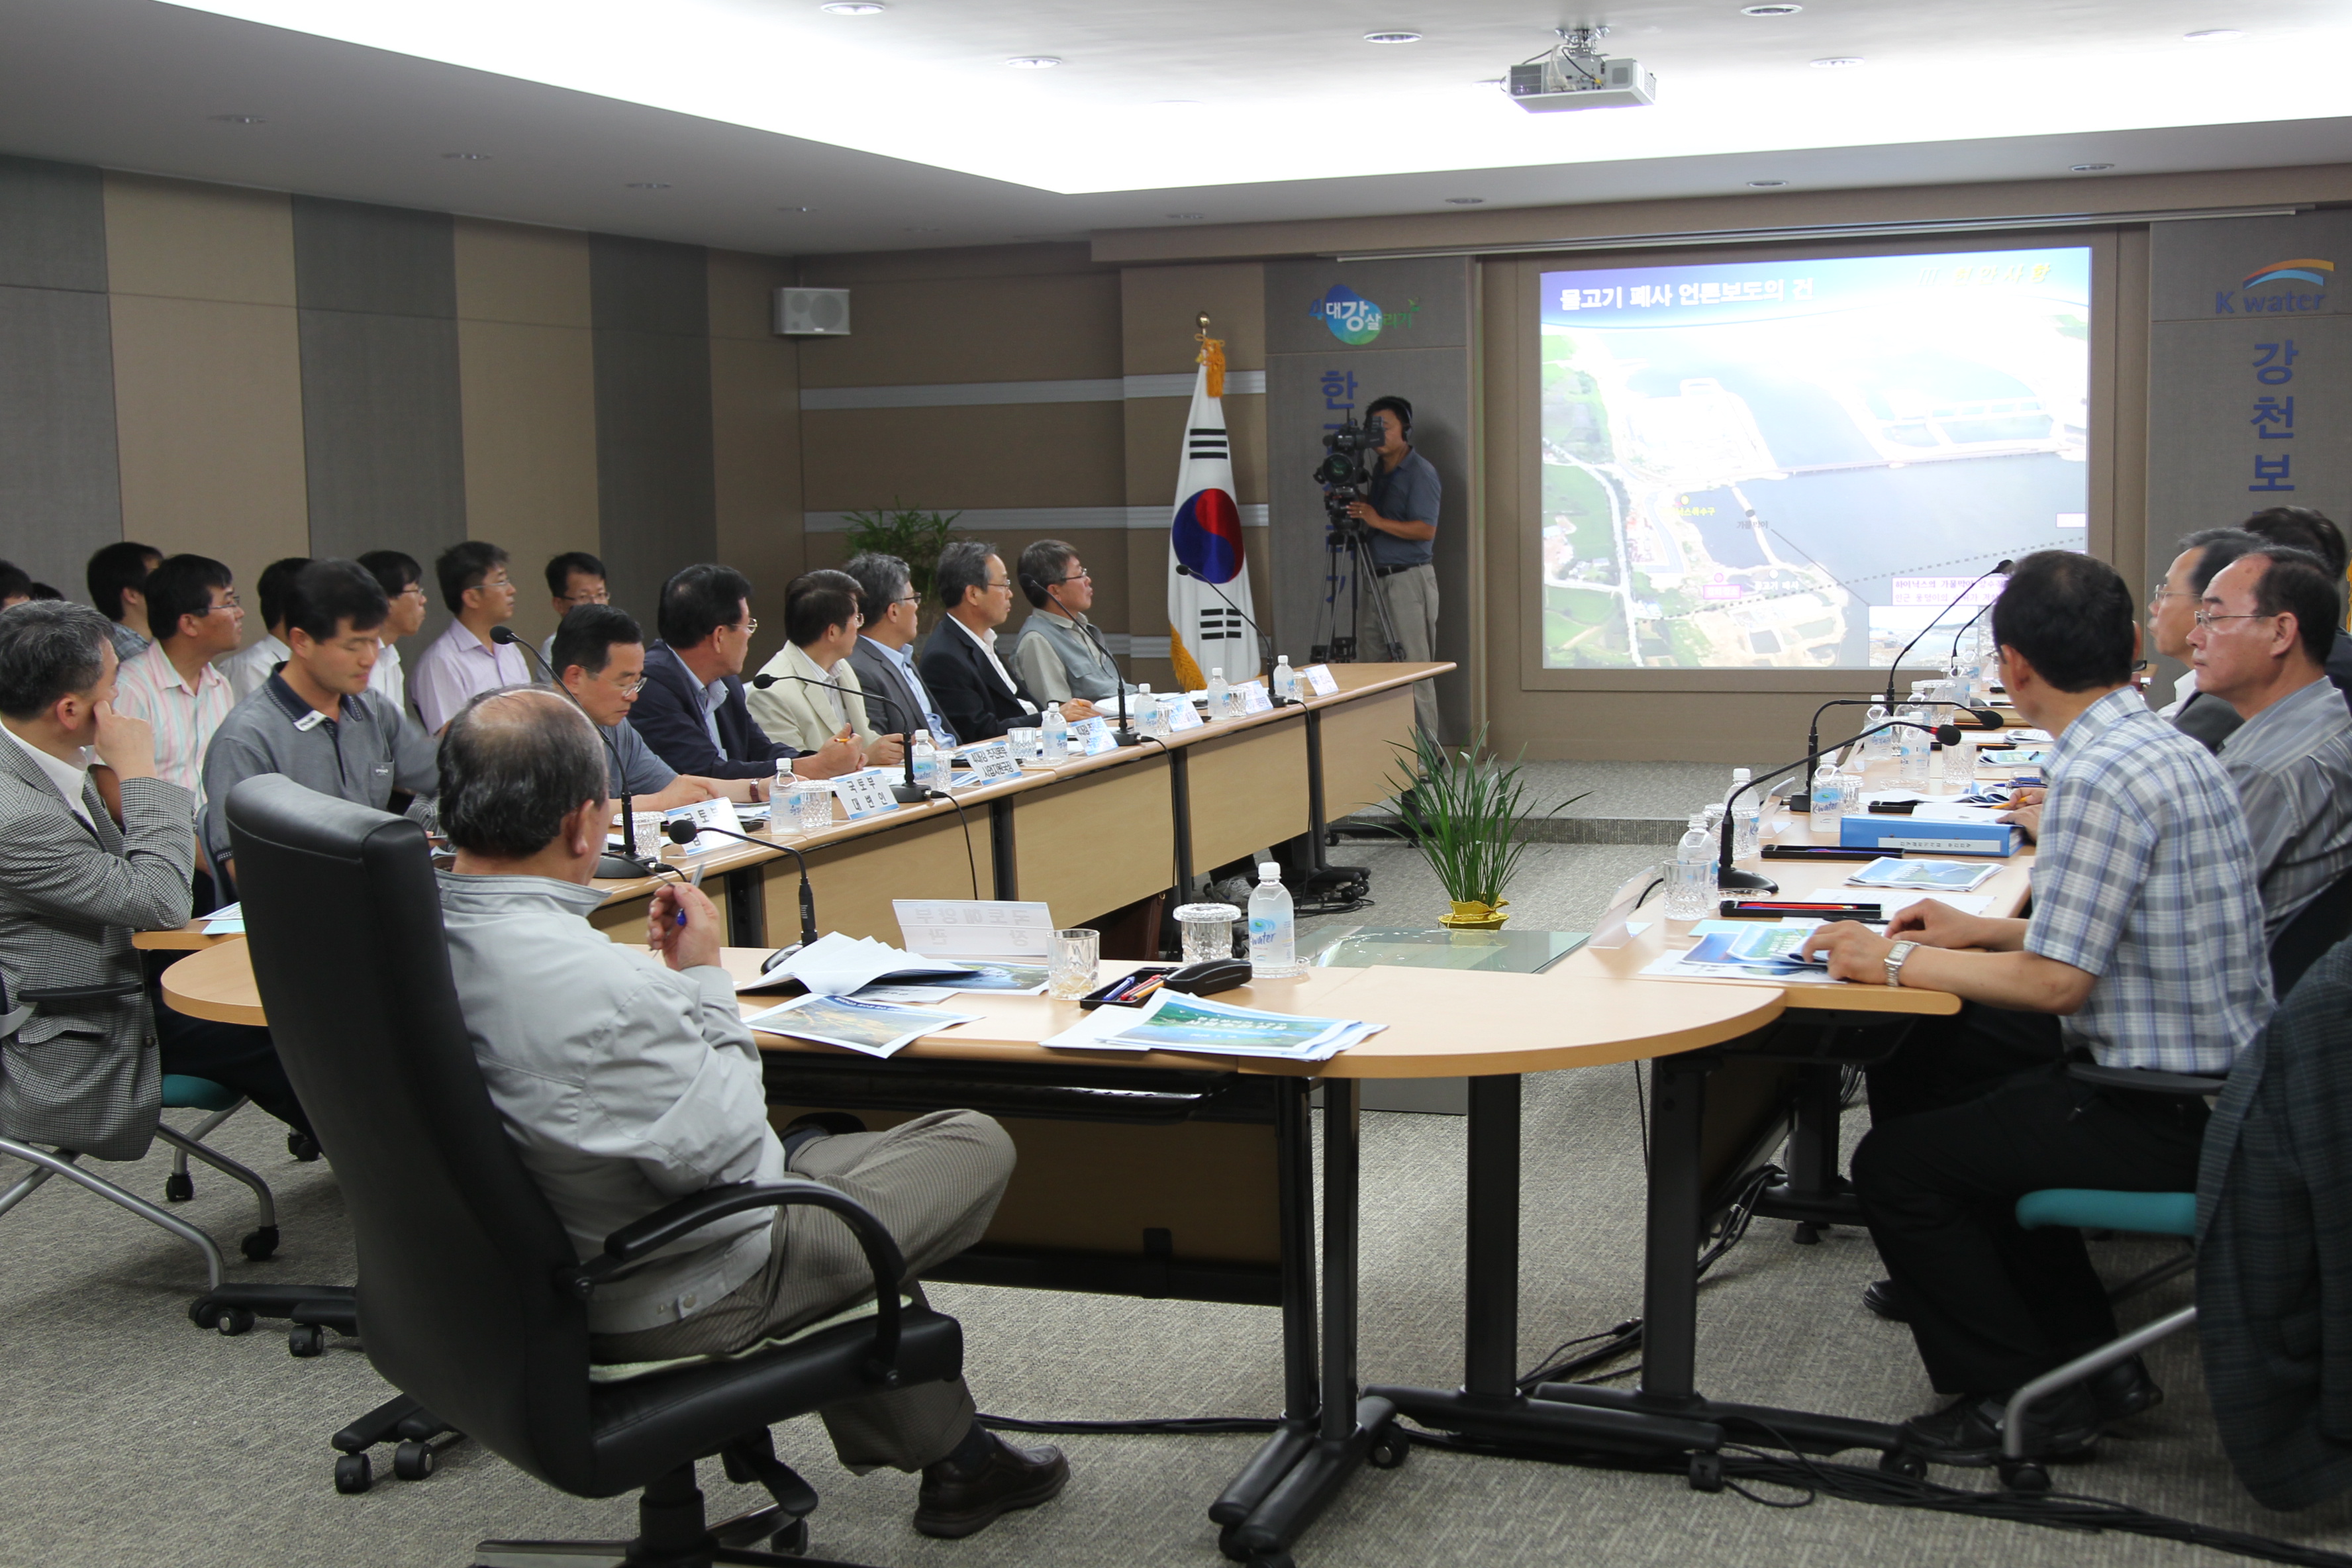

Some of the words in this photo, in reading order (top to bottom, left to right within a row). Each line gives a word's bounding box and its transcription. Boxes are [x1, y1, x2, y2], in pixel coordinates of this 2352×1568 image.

[1560, 286, 1622, 311] 물고기
[1630, 284, 1673, 308] 폐사
[1679, 279, 1785, 306] 언론보도의
[1792, 277, 1814, 301] 건
[2243, 289, 2325, 313] water
